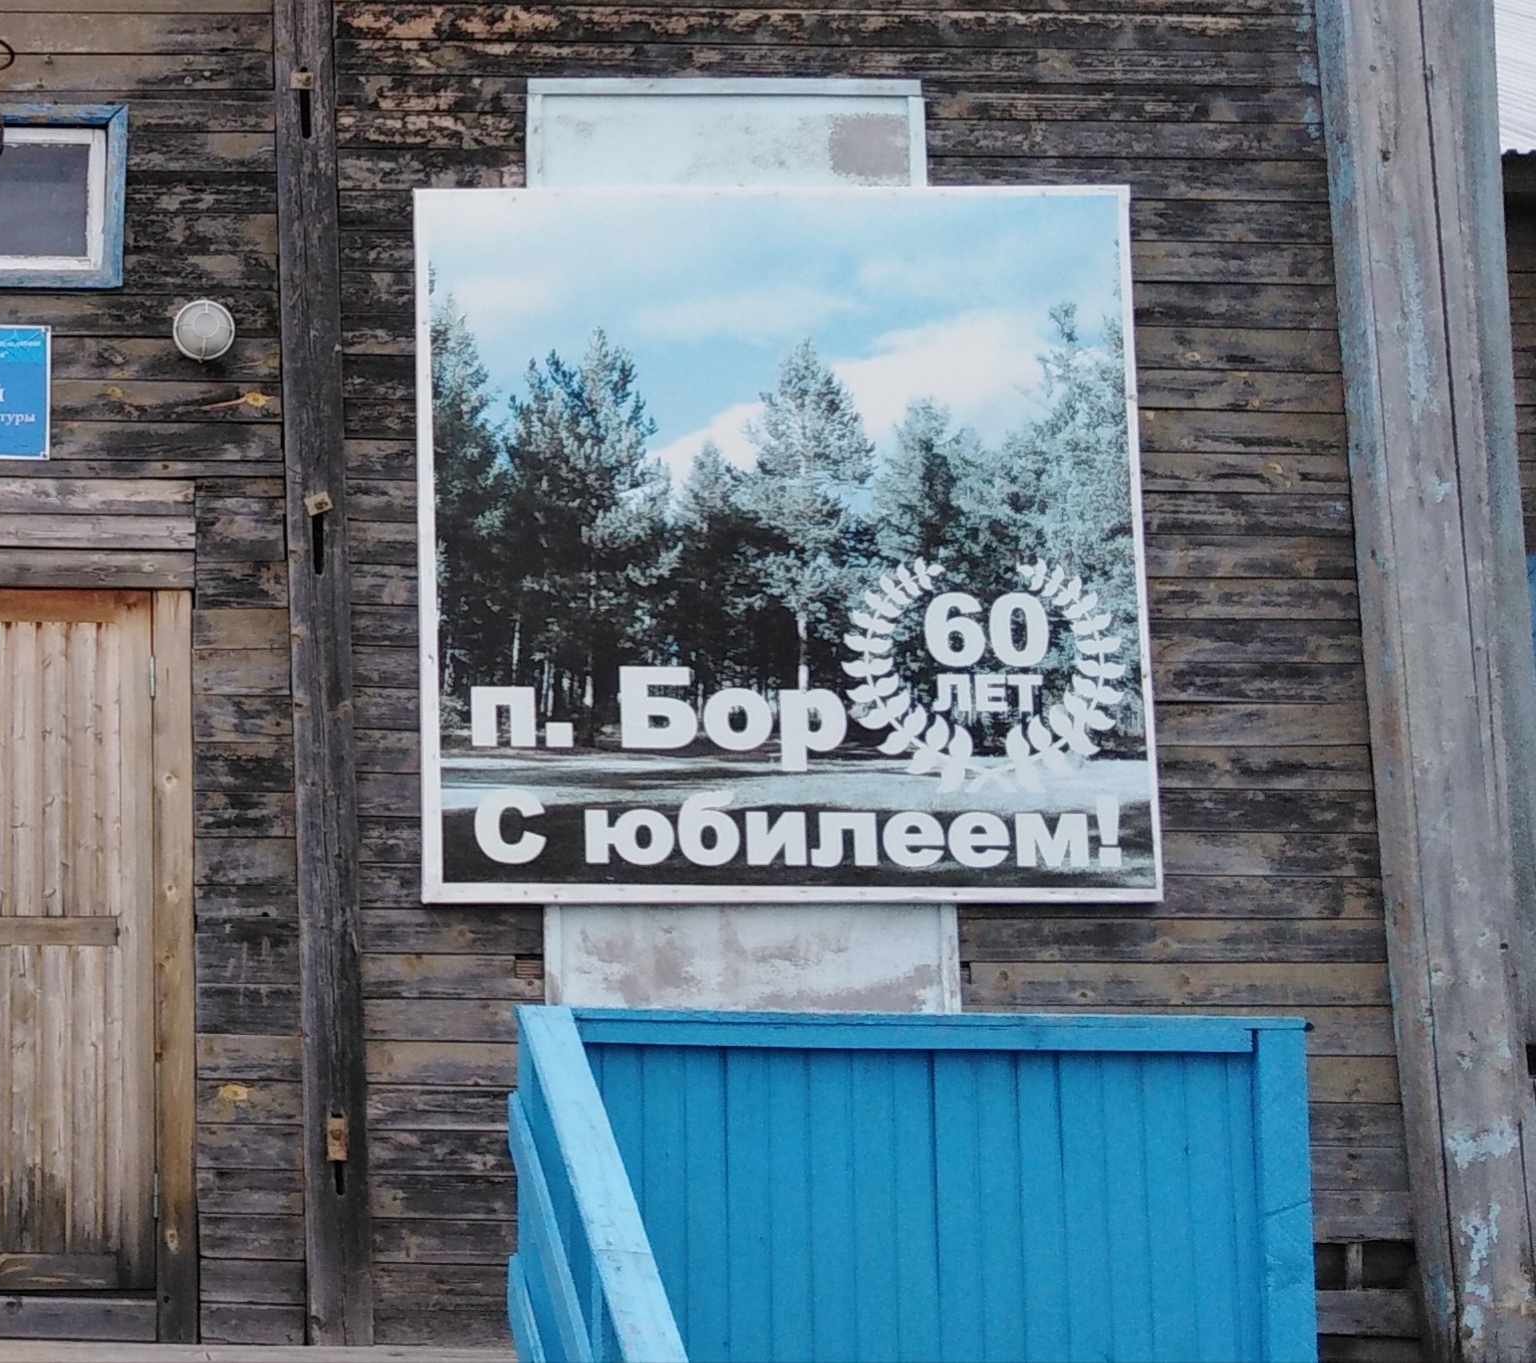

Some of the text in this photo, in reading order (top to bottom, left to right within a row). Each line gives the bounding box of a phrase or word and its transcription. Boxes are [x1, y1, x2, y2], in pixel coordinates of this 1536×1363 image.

[925, 592, 1051, 668] 60
[470, 666, 848, 772] п. Бор
[934, 674, 1043, 715] ЛЕТ
[475, 788, 1124, 868] С юбилеем!
